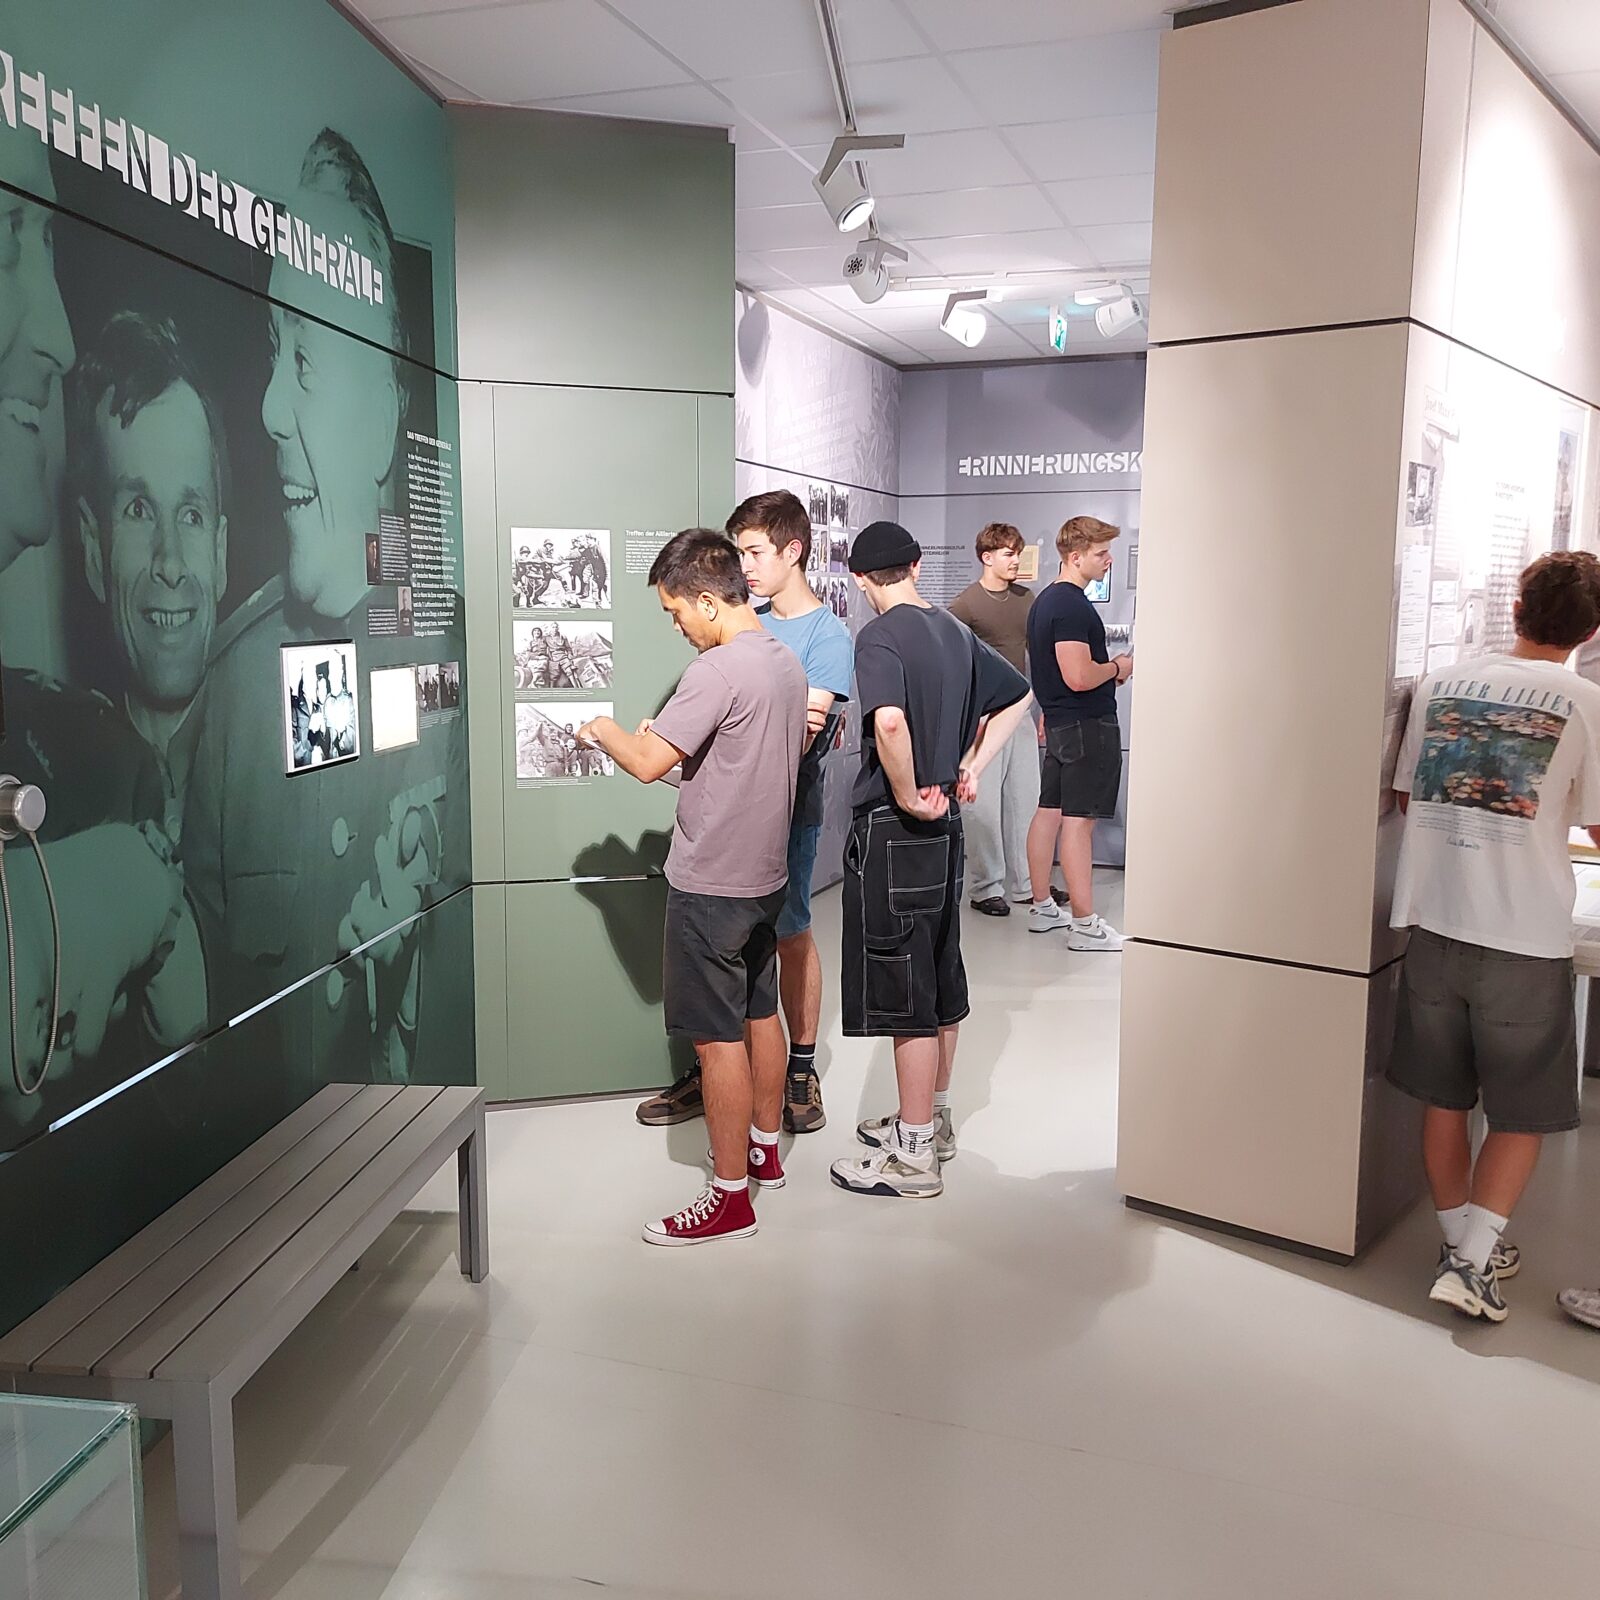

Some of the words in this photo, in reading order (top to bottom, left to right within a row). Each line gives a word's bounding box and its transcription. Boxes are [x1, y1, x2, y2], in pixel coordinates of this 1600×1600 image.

[172, 151, 241, 240] DER
[249, 195, 384, 306] GENERÄLE
[958, 451, 1142, 476] ERINNERUNGSK
[1501, 686, 1576, 717] LILIES
